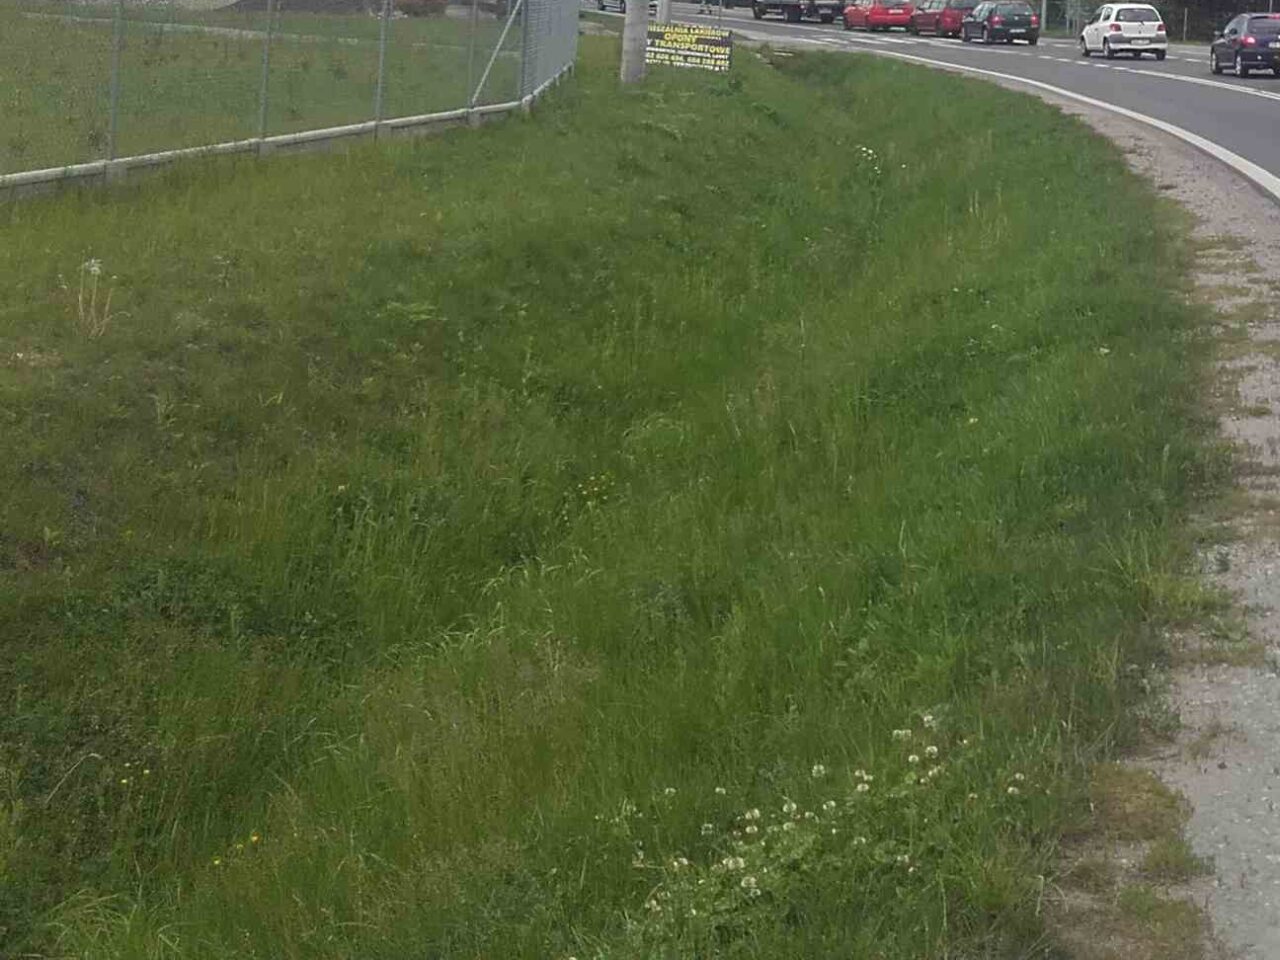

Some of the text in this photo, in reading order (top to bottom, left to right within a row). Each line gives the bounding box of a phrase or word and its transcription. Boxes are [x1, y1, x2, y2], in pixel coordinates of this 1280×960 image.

[648, 25, 688, 34] IESZALNIA
[664, 32, 698, 43] OPONY
[655, 39, 731, 54] TRANSPORTOWE
